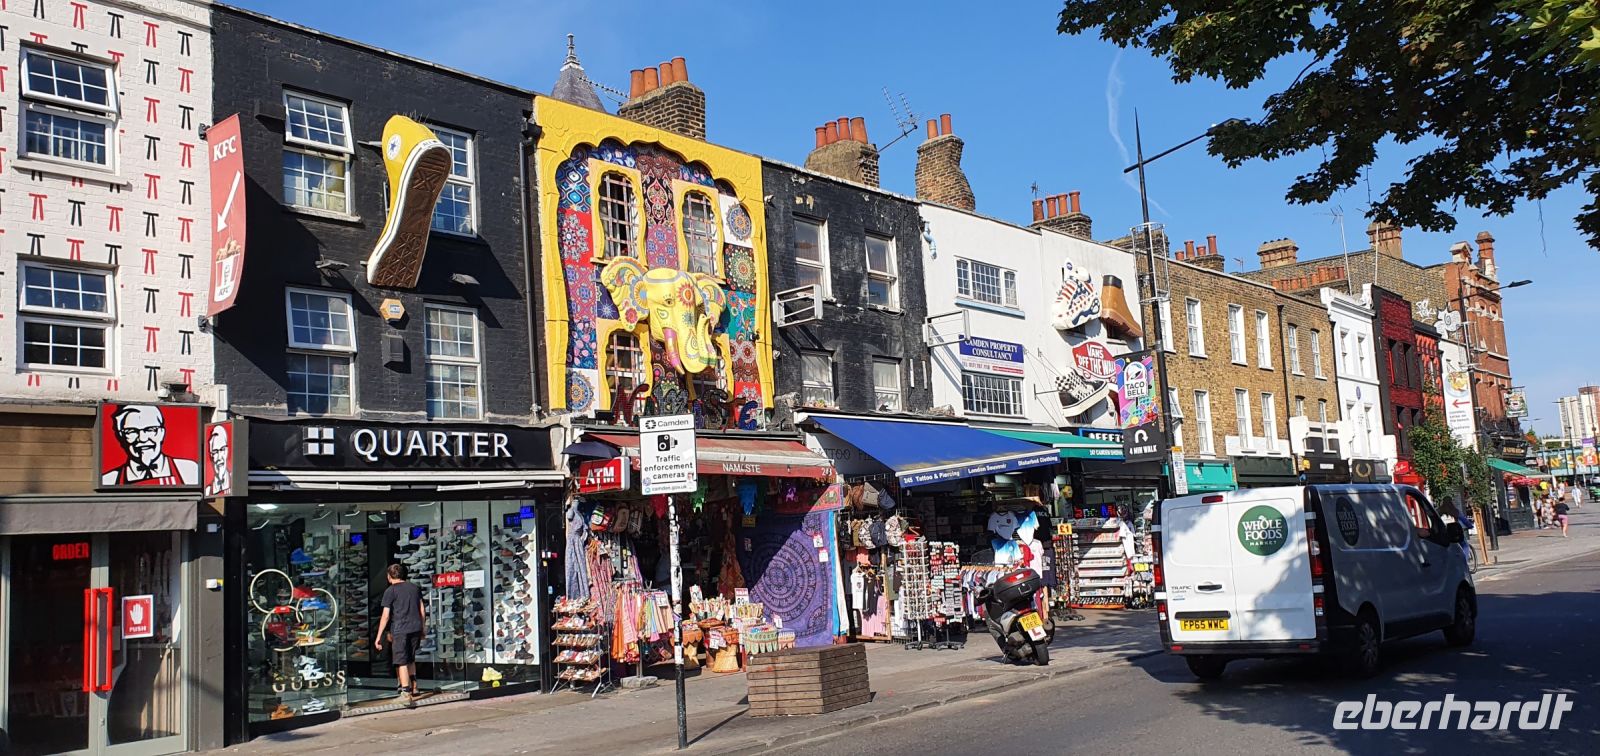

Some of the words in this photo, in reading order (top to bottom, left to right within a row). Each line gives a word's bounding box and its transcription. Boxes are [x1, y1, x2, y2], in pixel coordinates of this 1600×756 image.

[213, 135, 237, 162] KFC
[965, 339, 989, 349] CAMDEN
[990, 341, 1018, 353] PROPERTY
[1086, 344, 1104, 359] VANS
[972, 348, 1012, 360] CONSULTANCY
[1125, 381, 1145, 389] TACO
[1127, 389, 1145, 397] BELL
[658, 419, 689, 428] Camden
[353, 429, 512, 462] QUARTER
[1134, 446, 1143, 455] MIN
[1143, 445, 1157, 453] WALK
[656, 455, 681, 463] Traffic
[644, 462, 694, 472] enforcement
[968, 465, 986, 474] London
[586, 466, 615, 485] ATM
[653, 472, 685, 480] cameras
[915, 473, 933, 482] Tattoo
[933, 472, 939, 480] &
[939, 470, 960, 479] Piercing
[1059, 523, 1069, 534] £1
[1242, 518, 1283, 531] WHOLE
[1245, 529, 1283, 541] FOODS
[53, 542, 89, 560] ORDER
[1184, 620, 1206, 629] FP65
[1207, 619, 1225, 629] WWC
[1031, 628, 1041, 636] L
